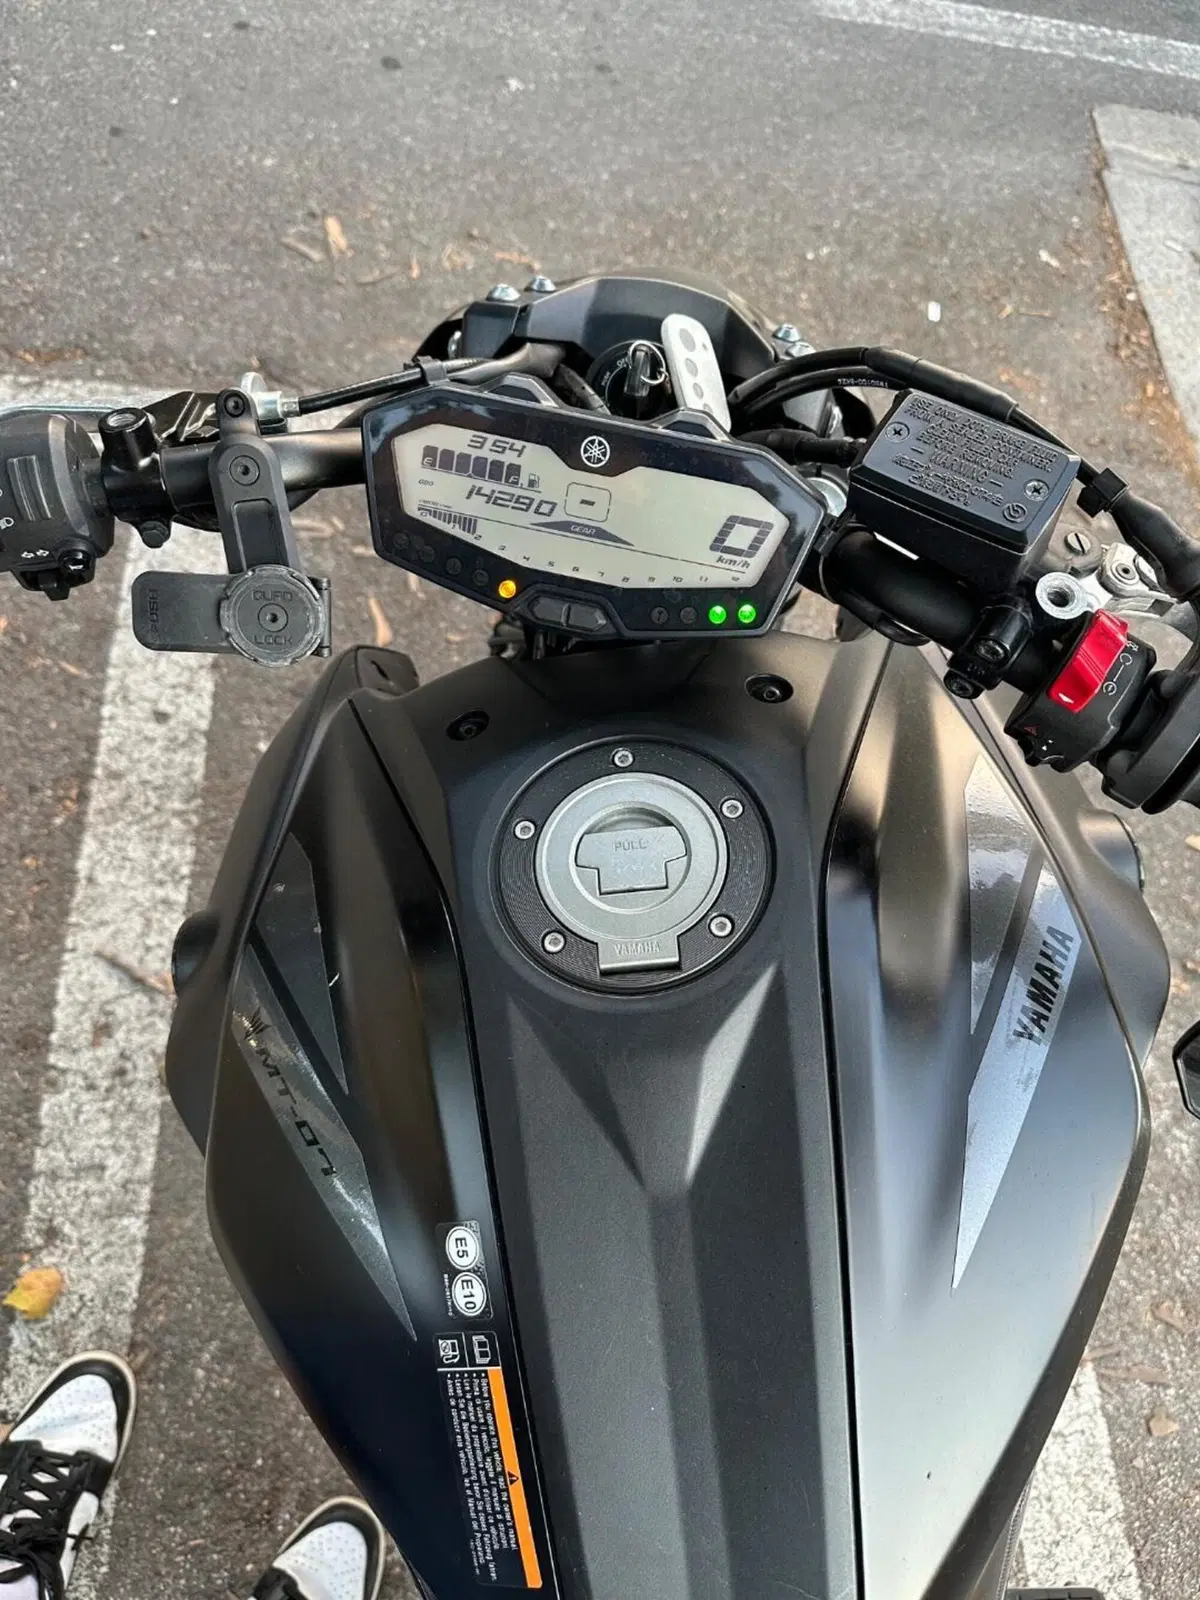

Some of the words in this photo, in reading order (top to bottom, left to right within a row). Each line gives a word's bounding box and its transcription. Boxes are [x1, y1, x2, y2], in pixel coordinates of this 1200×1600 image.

[928, 448, 989, 484] WARNING
[465, 484, 558, 517] 14290
[570, 524, 596, 535] GEAR
[709, 515, 774, 558] 0
[716, 555, 750, 569] km/h
[253, 590, 293, 601] QUAD
[254, 635, 293, 646] LOCK
[614, 841, 647, 852] PULL
[613, 940, 661, 957] YAMAHA
[1012, 925, 1074, 1046] YAMAHA
[455, 1237, 469, 1258] E5
[461, 1279, 477, 1310] E10
